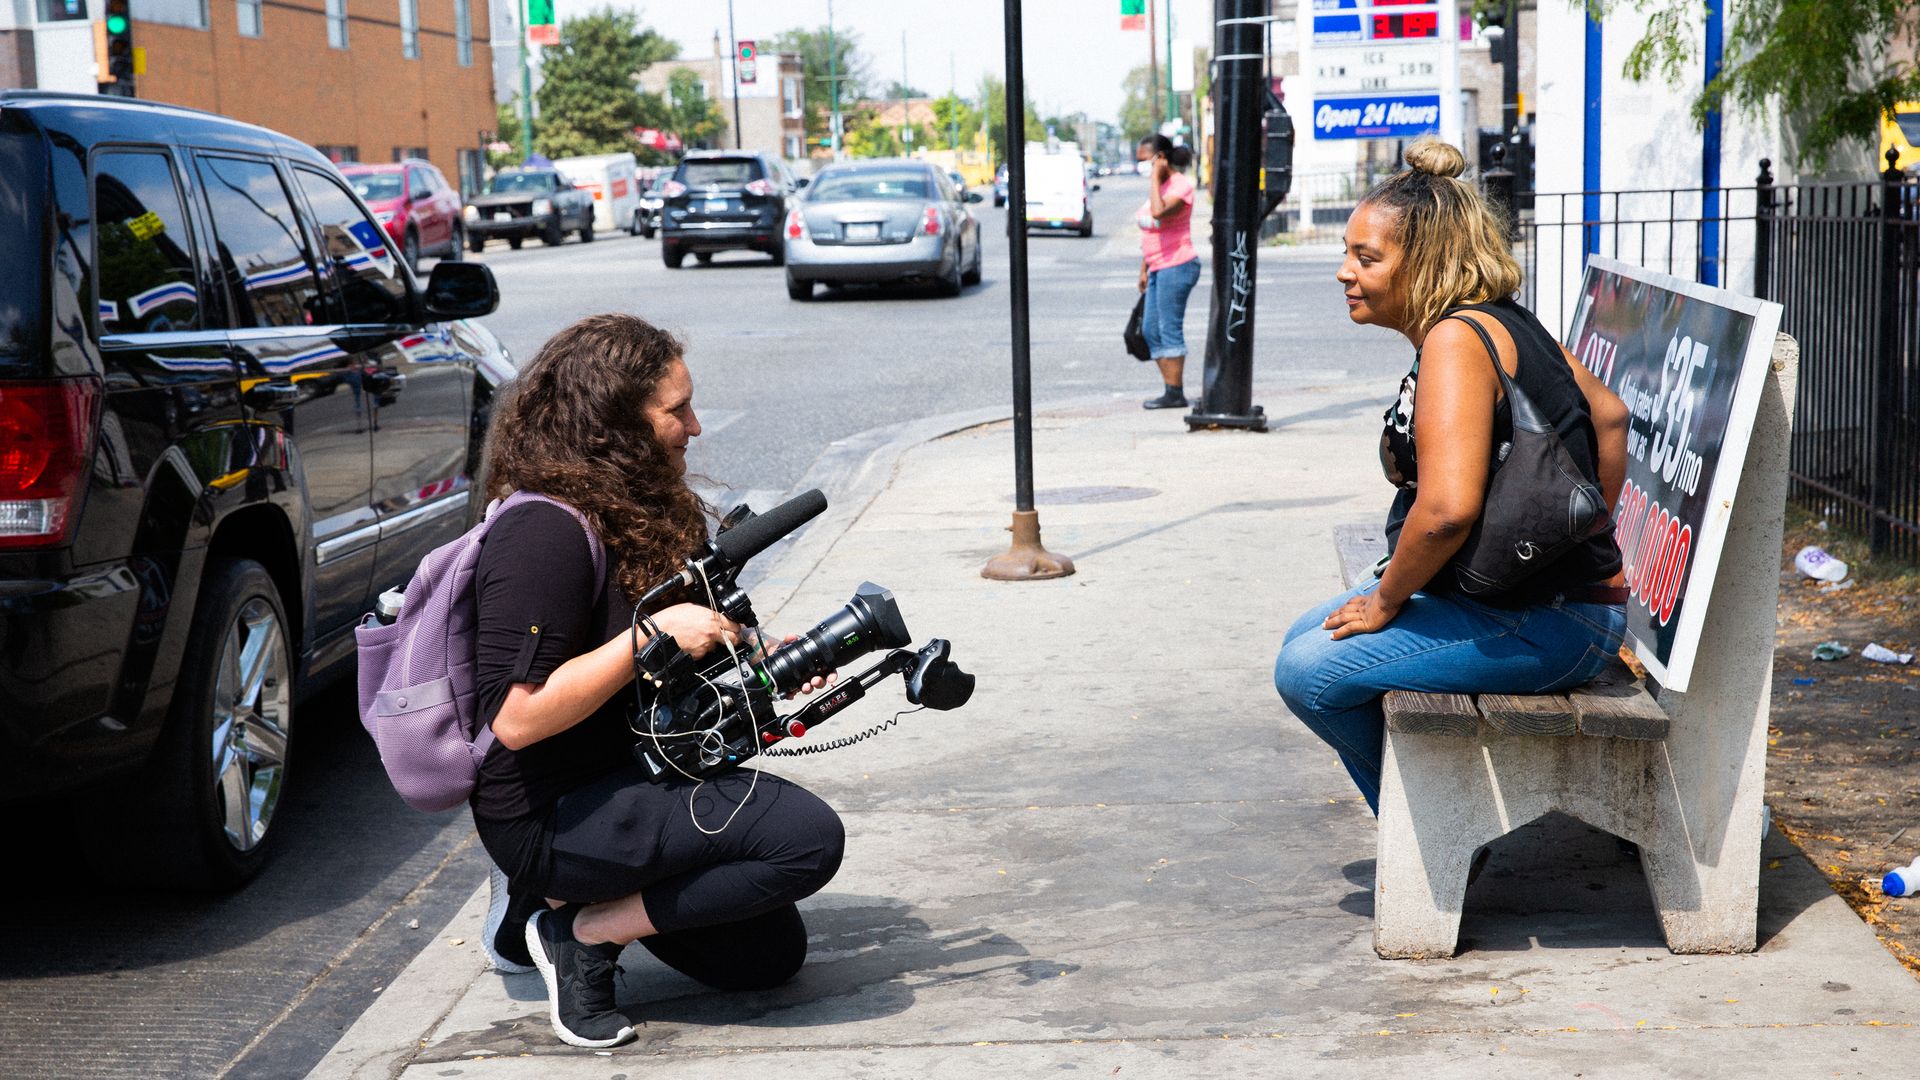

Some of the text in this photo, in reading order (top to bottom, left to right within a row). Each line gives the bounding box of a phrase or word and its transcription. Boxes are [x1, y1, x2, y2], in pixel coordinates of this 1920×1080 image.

[1315, 102, 1438, 133] Open 24 Hours
[1636, 434, 1648, 462] as
[819, 690, 849, 712] SHAPE
